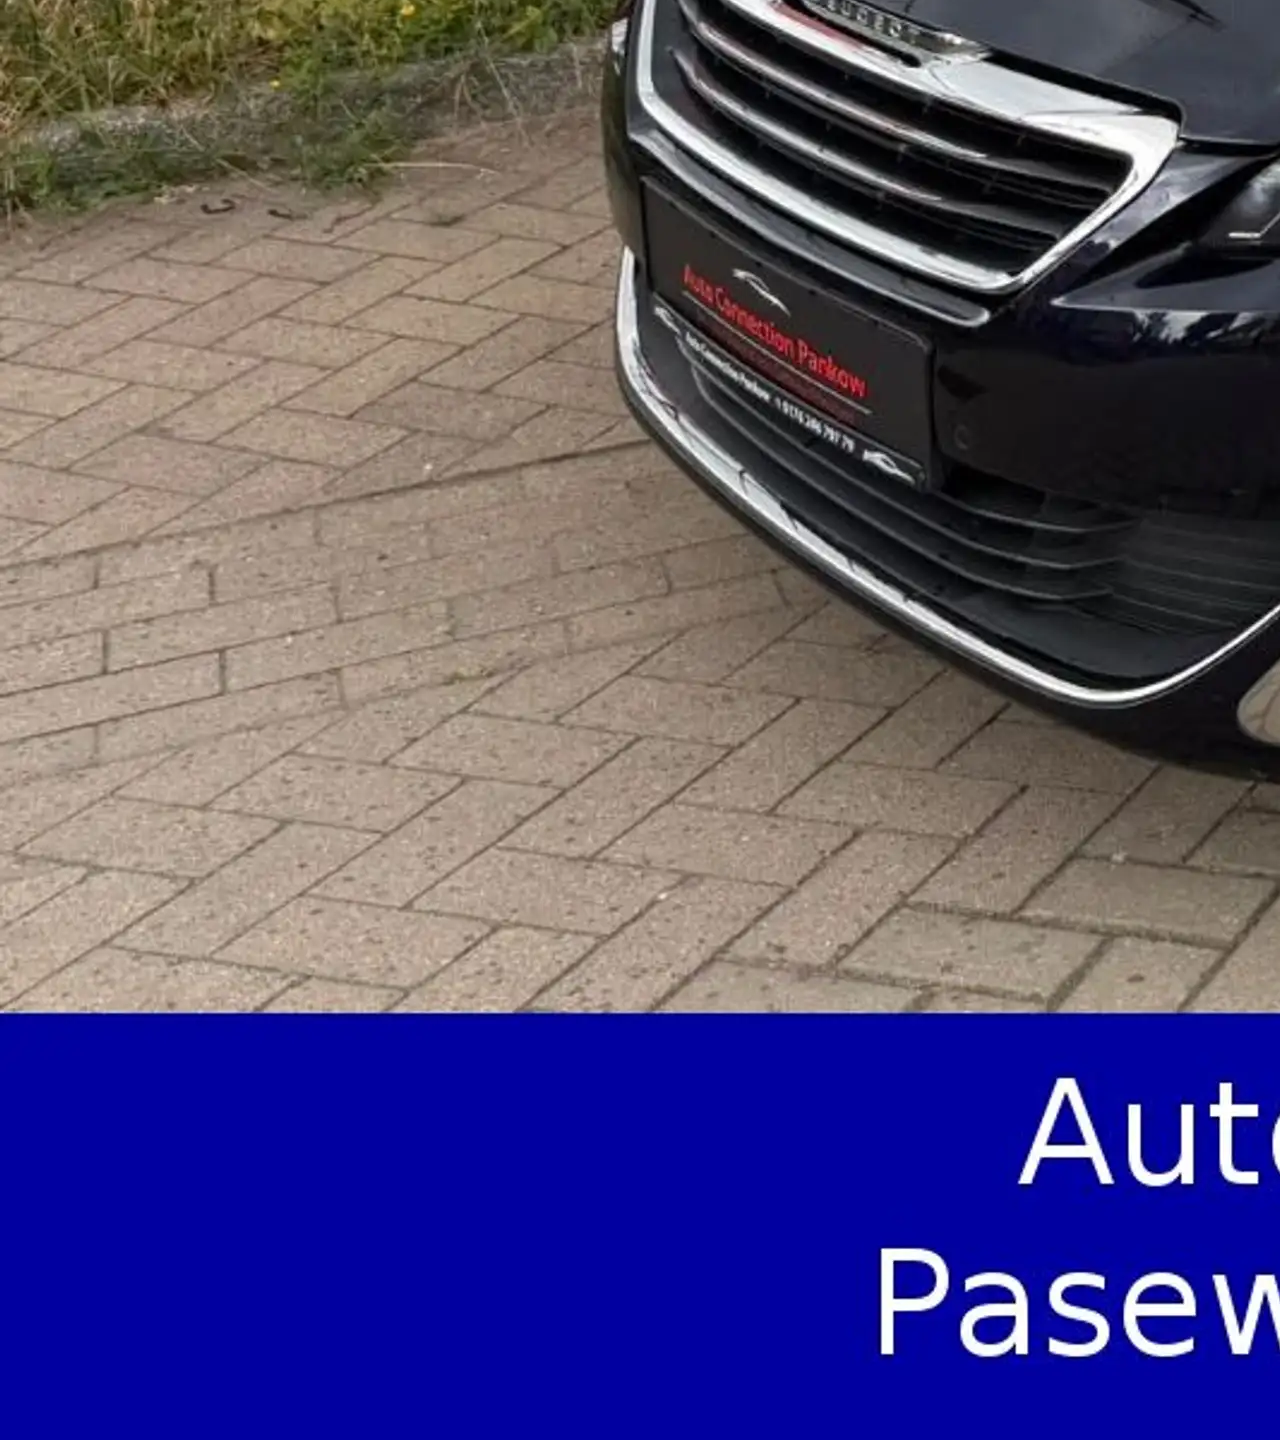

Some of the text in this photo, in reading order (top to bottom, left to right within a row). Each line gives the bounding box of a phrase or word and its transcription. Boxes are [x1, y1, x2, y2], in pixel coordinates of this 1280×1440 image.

[682, 264, 867, 398] Auto Connection Pankow
